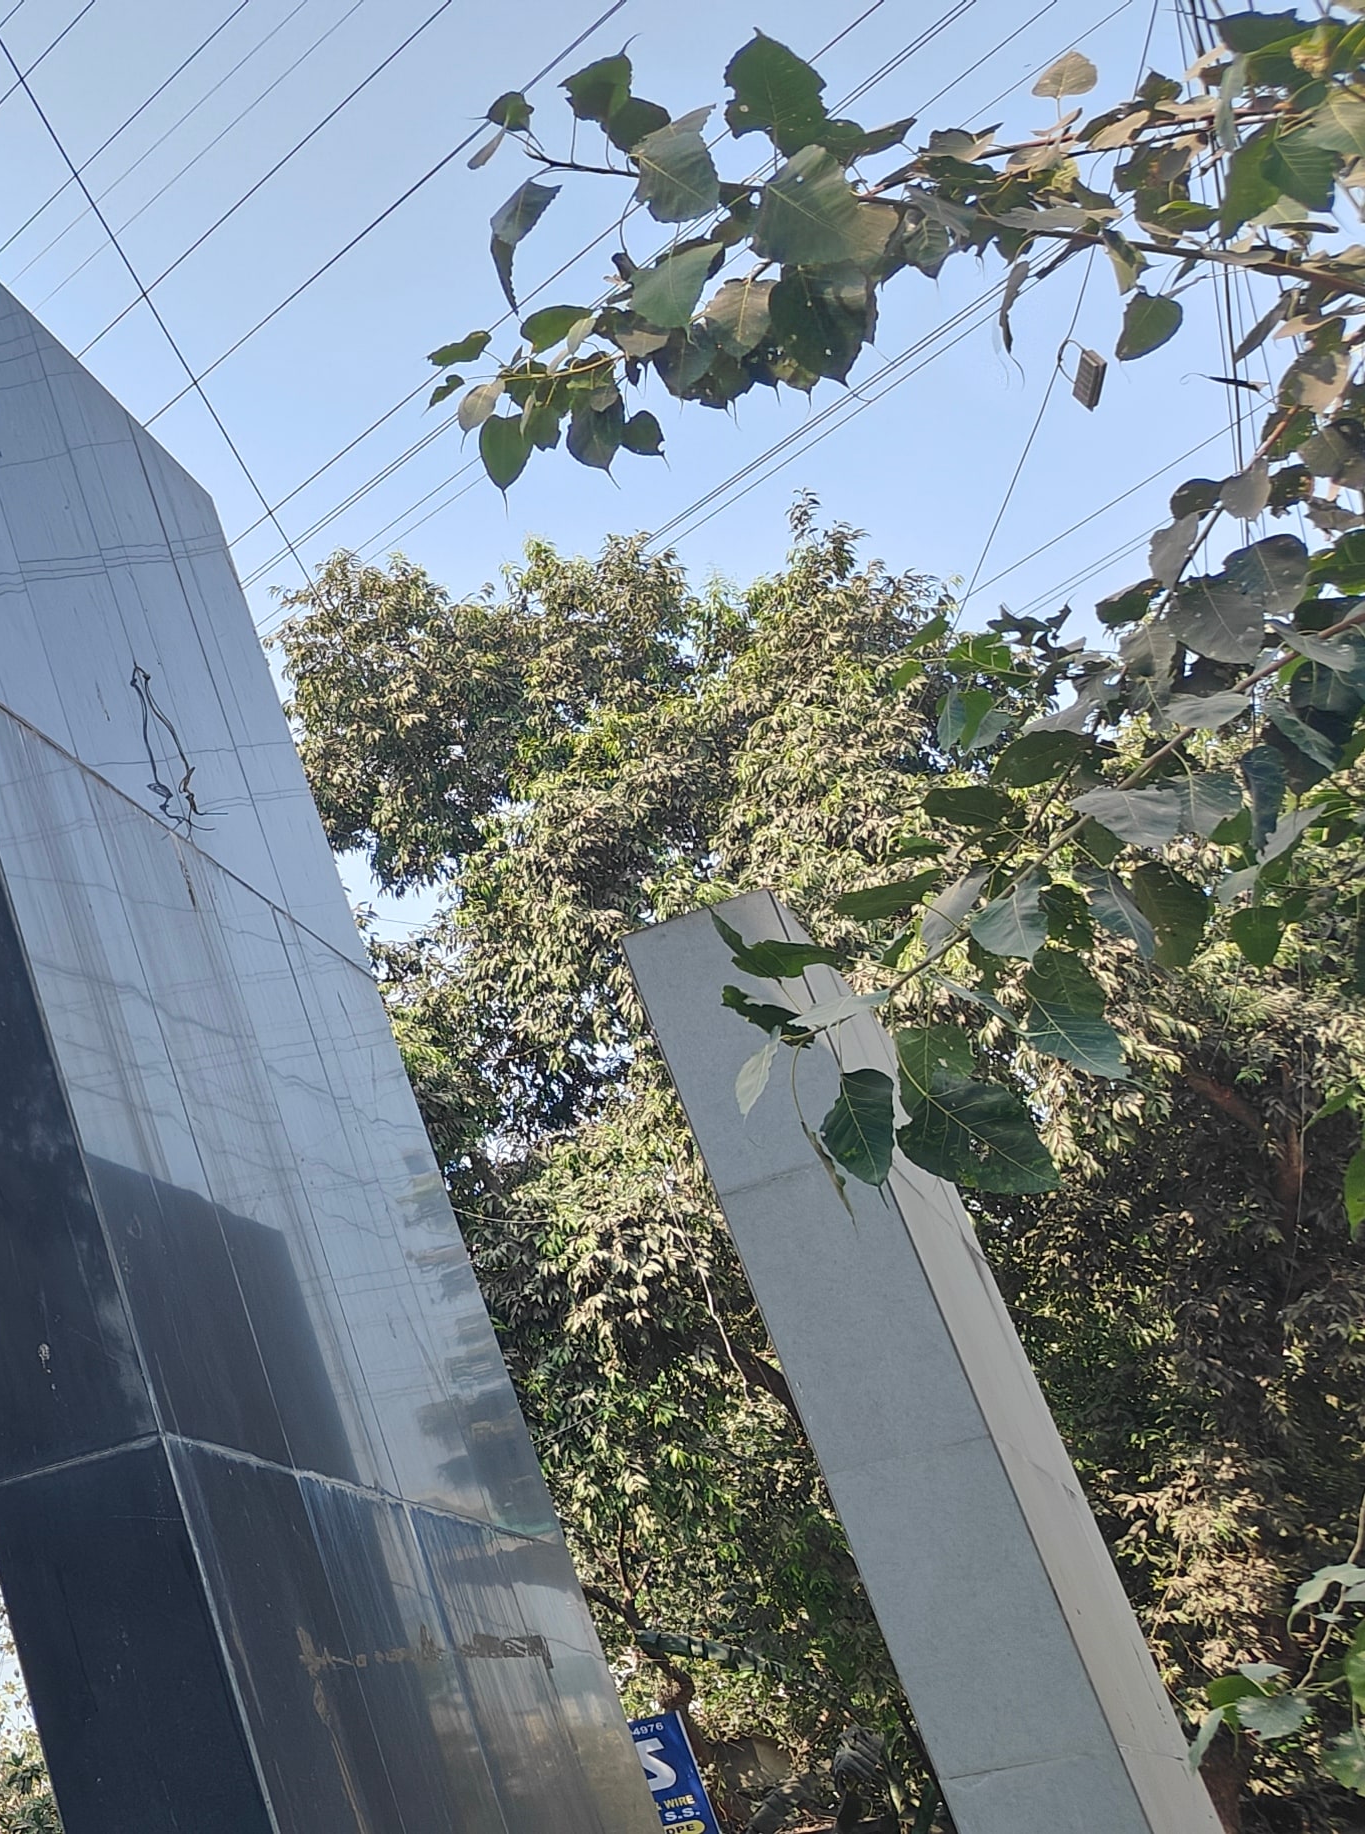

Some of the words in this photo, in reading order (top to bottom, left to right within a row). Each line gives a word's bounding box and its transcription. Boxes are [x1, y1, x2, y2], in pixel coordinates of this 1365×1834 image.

[631, 1721, 664, 1736] 4976
[663, 1794, 695, 1810] WIRE
[664, 1807, 701, 1822] S.S.
